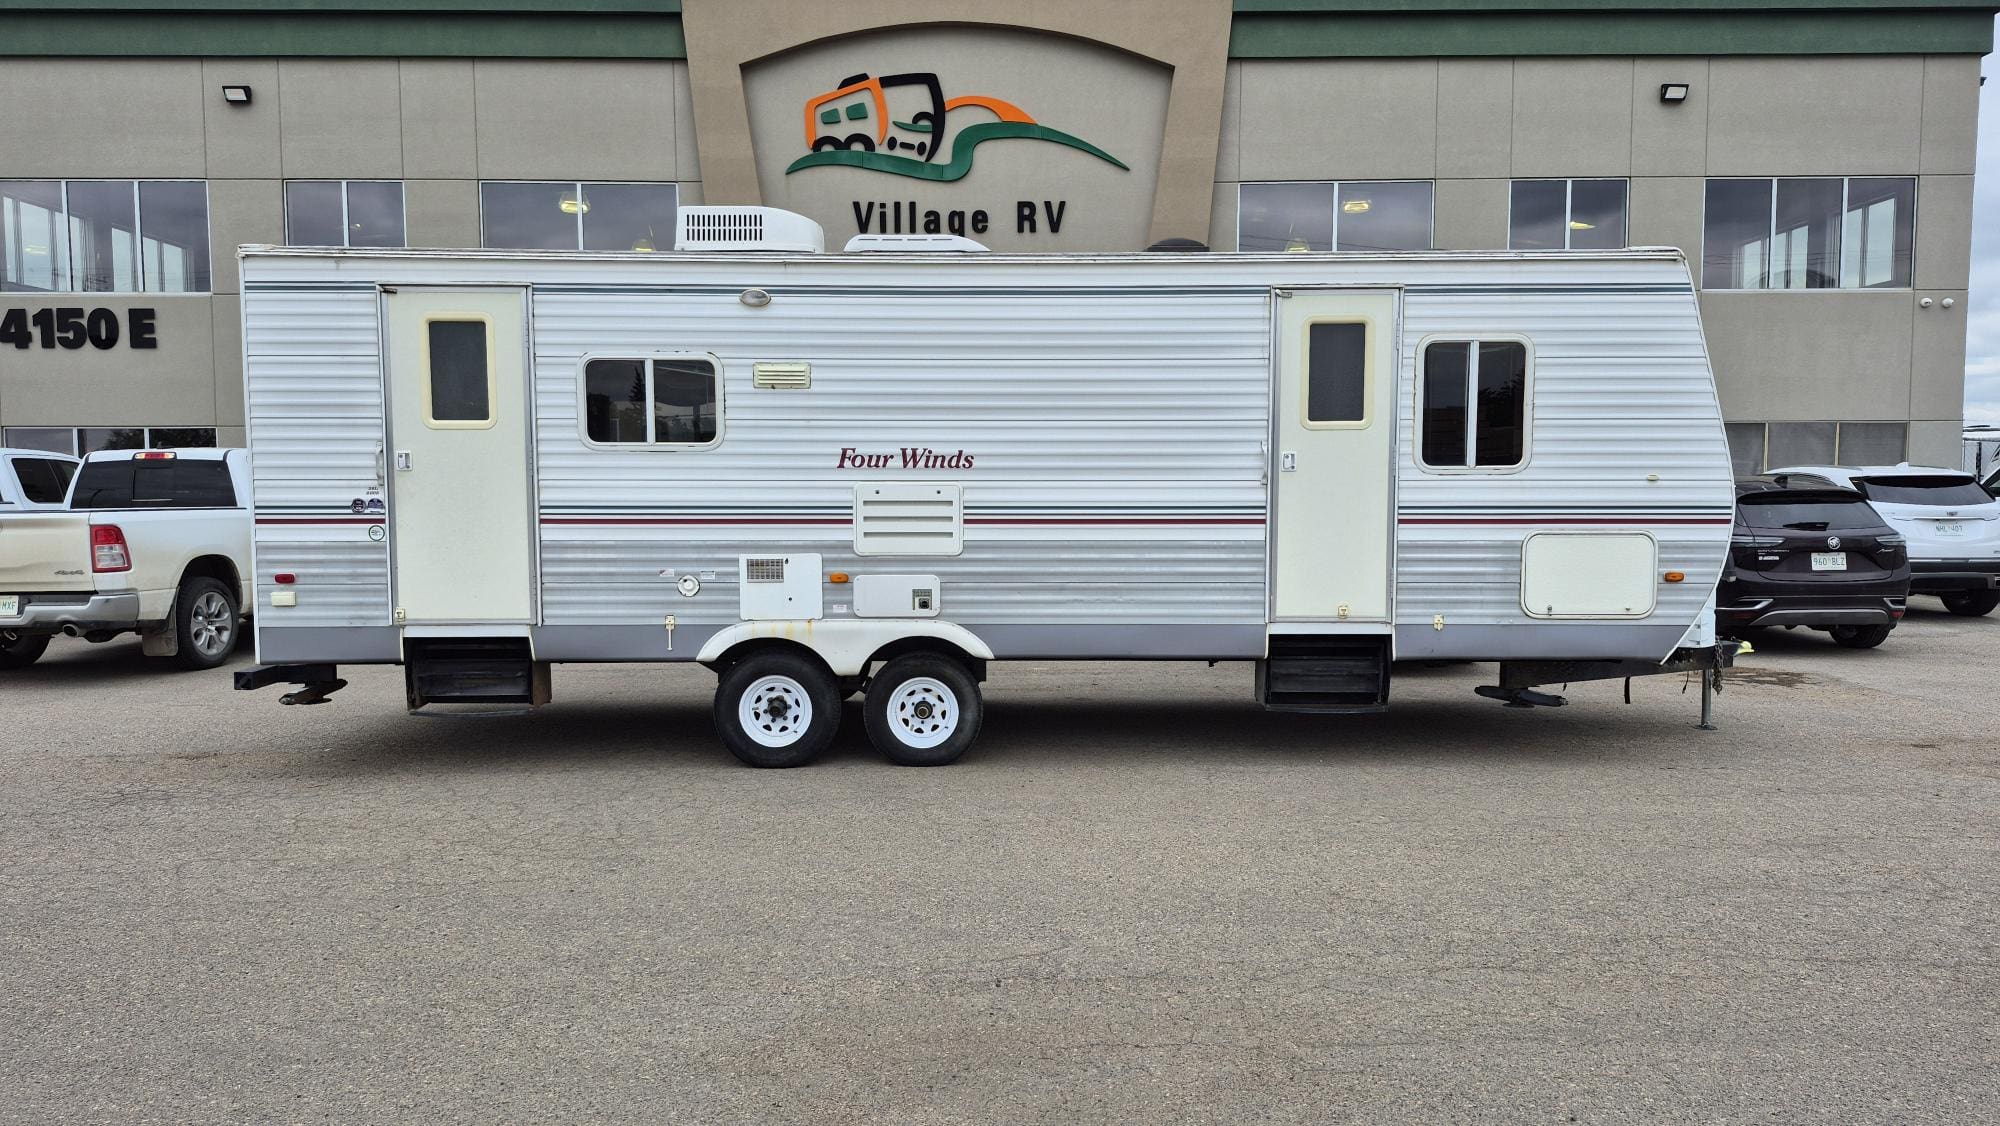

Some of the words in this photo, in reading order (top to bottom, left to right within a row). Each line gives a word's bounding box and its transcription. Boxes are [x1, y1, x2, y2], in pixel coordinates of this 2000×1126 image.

[852, 201, 989, 237] Village
[1016, 200, 1066, 234] RV
[0, 307, 119, 350] 4150
[128, 308, 157, 349] E
[836, 447, 895, 469] Four
[899, 447, 975, 469] Winds
